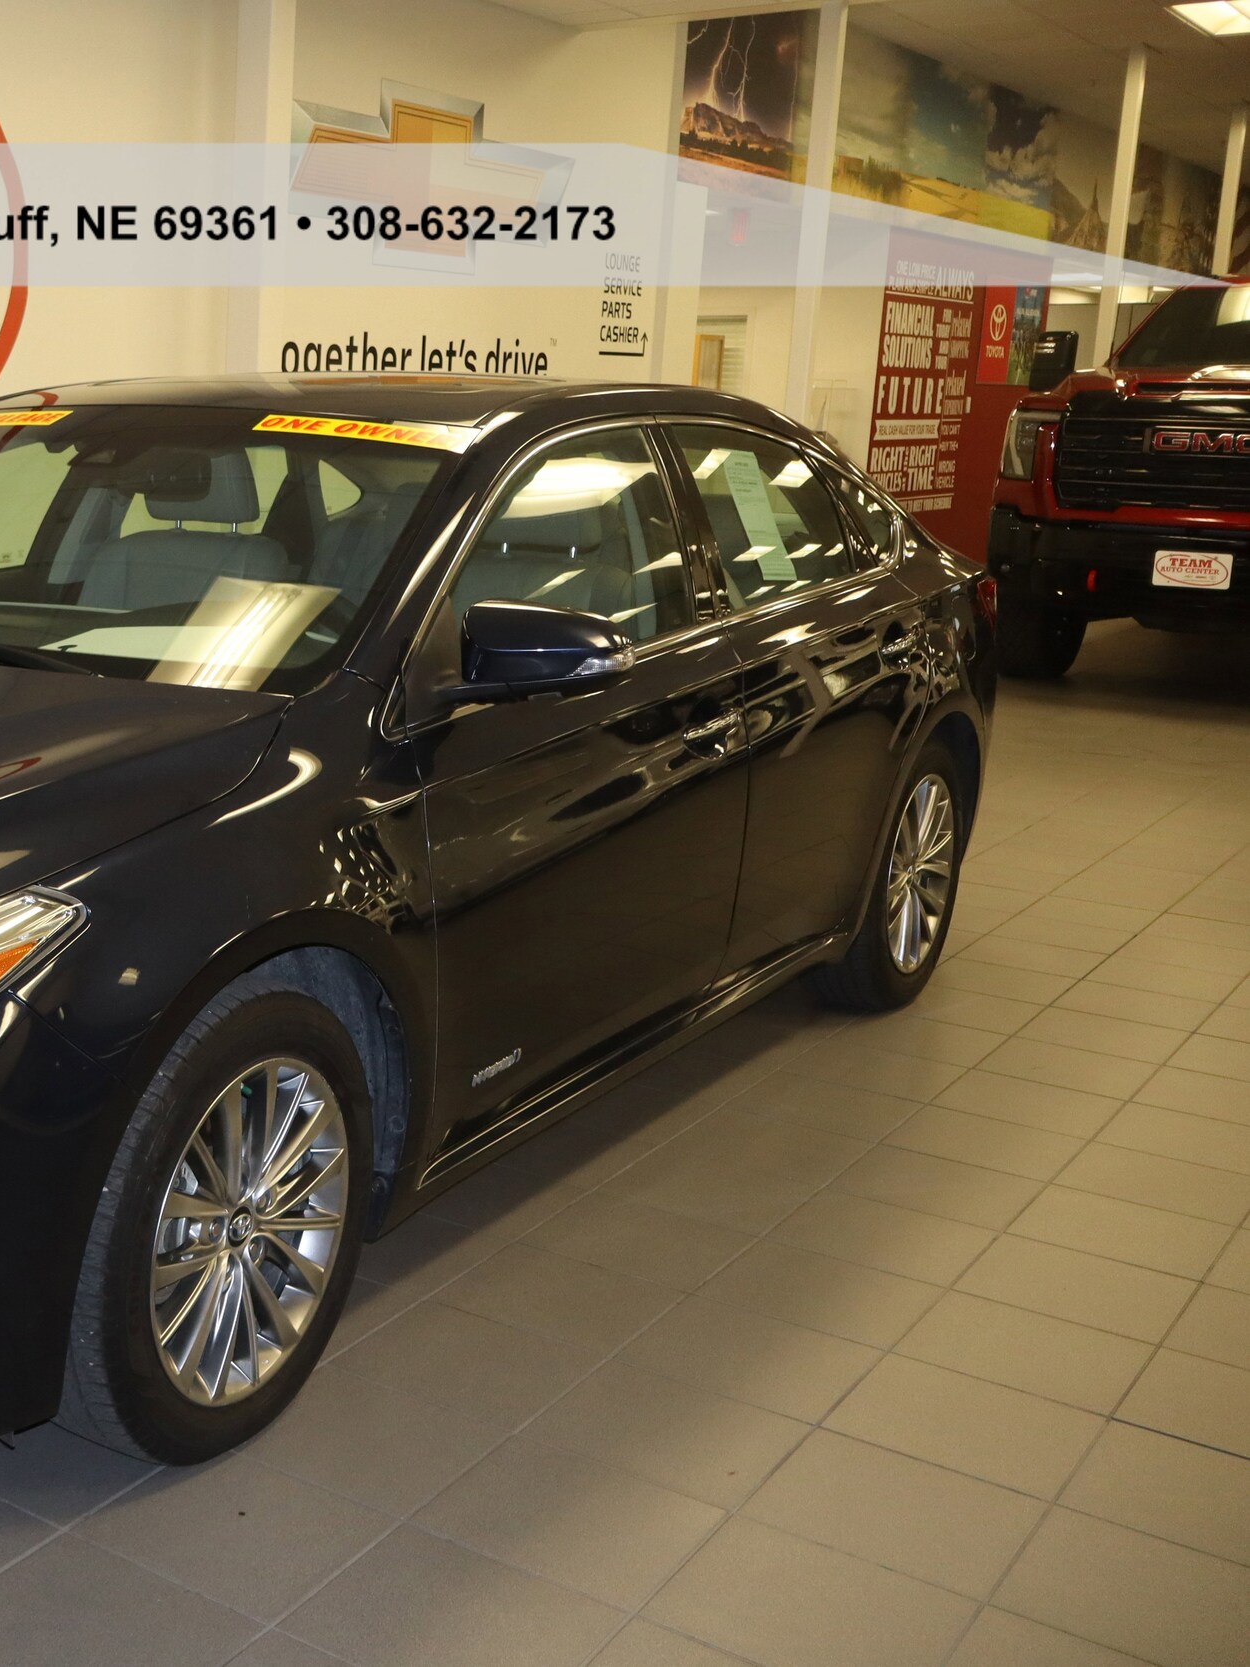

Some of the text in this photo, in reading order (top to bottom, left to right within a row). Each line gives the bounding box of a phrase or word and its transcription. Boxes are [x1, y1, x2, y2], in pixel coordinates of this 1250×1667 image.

[605, 253, 641, 273] LOUNGE
[896, 260, 908, 276] ONE
[604, 276, 643, 297] SERVICE
[935, 267, 974, 301] ALWAYS
[601, 301, 632, 319] PARTS
[885, 301, 934, 337] FINANCIAL
[600, 325, 639, 343] CASHIER
[485, 338, 548, 375] drive
[882, 334, 932, 369] SOLUTIONS
[986, 345, 1005, 358] TOYOTA
[876, 375, 944, 415] FUTURE
[261, 416, 328, 431] ONE
[870, 446, 905, 472] RIGHT
[908, 445, 937, 467] RIGHT
[938, 460, 955, 473] WRONG
[870, 472, 902, 492] EHICLES
[907, 467, 935, 491] TIME
[1170, 558, 1212, 568] TEAM
[1185, 567, 1219, 575] CENTER
